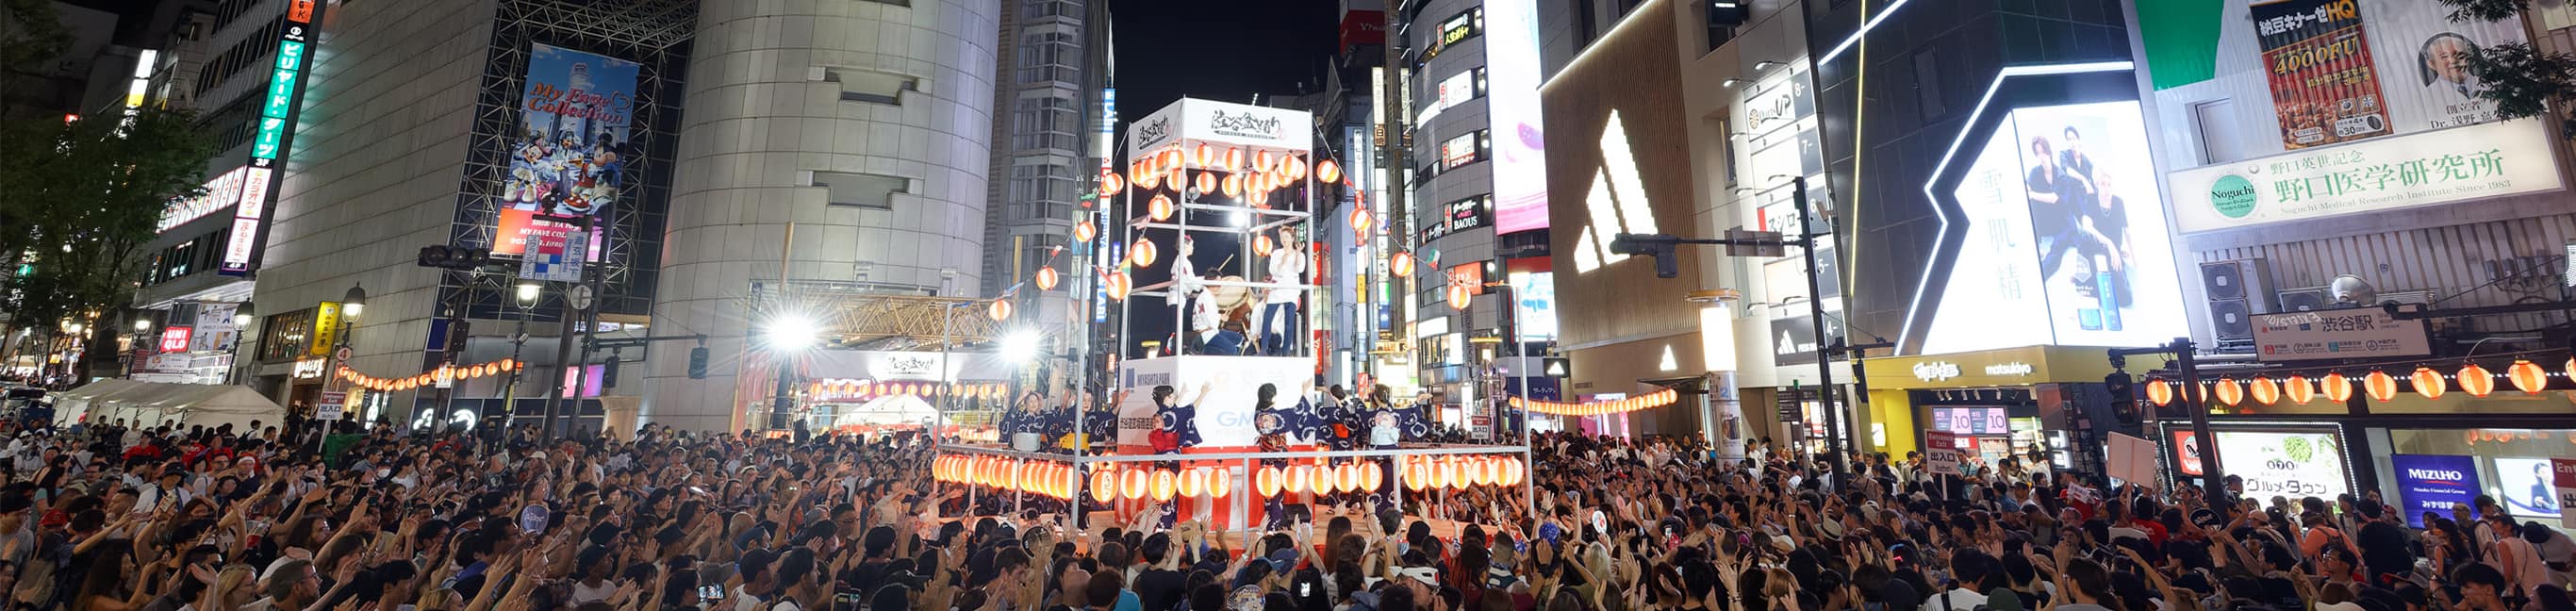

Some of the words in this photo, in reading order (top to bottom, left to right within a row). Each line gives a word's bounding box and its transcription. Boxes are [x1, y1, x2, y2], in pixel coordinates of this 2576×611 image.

[530, 82, 564, 102] My
[528, 97, 623, 123] Collection
[2270, 150, 2366, 175] 野口英世記念
[2274, 148, 2504, 204] 野口医学研究所
[2212, 185, 2254, 200] Noguchi
[2320, 200, 2355, 211] Medical
[2359, 192, 2403, 205] Research
[2407, 187, 2452, 199] Institute
[2456, 184, 2485, 194] Since
[2488, 179, 2512, 190] 1983
[2322, 315, 2374, 333] 渋谷駅
[167, 330, 188, 339] UNI
[164, 340, 186, 350] QLO
[1216, 410, 1255, 426] GM
[1930, 453, 1956, 462] 出入口
[2408, 469, 2463, 481] MIZUHO
